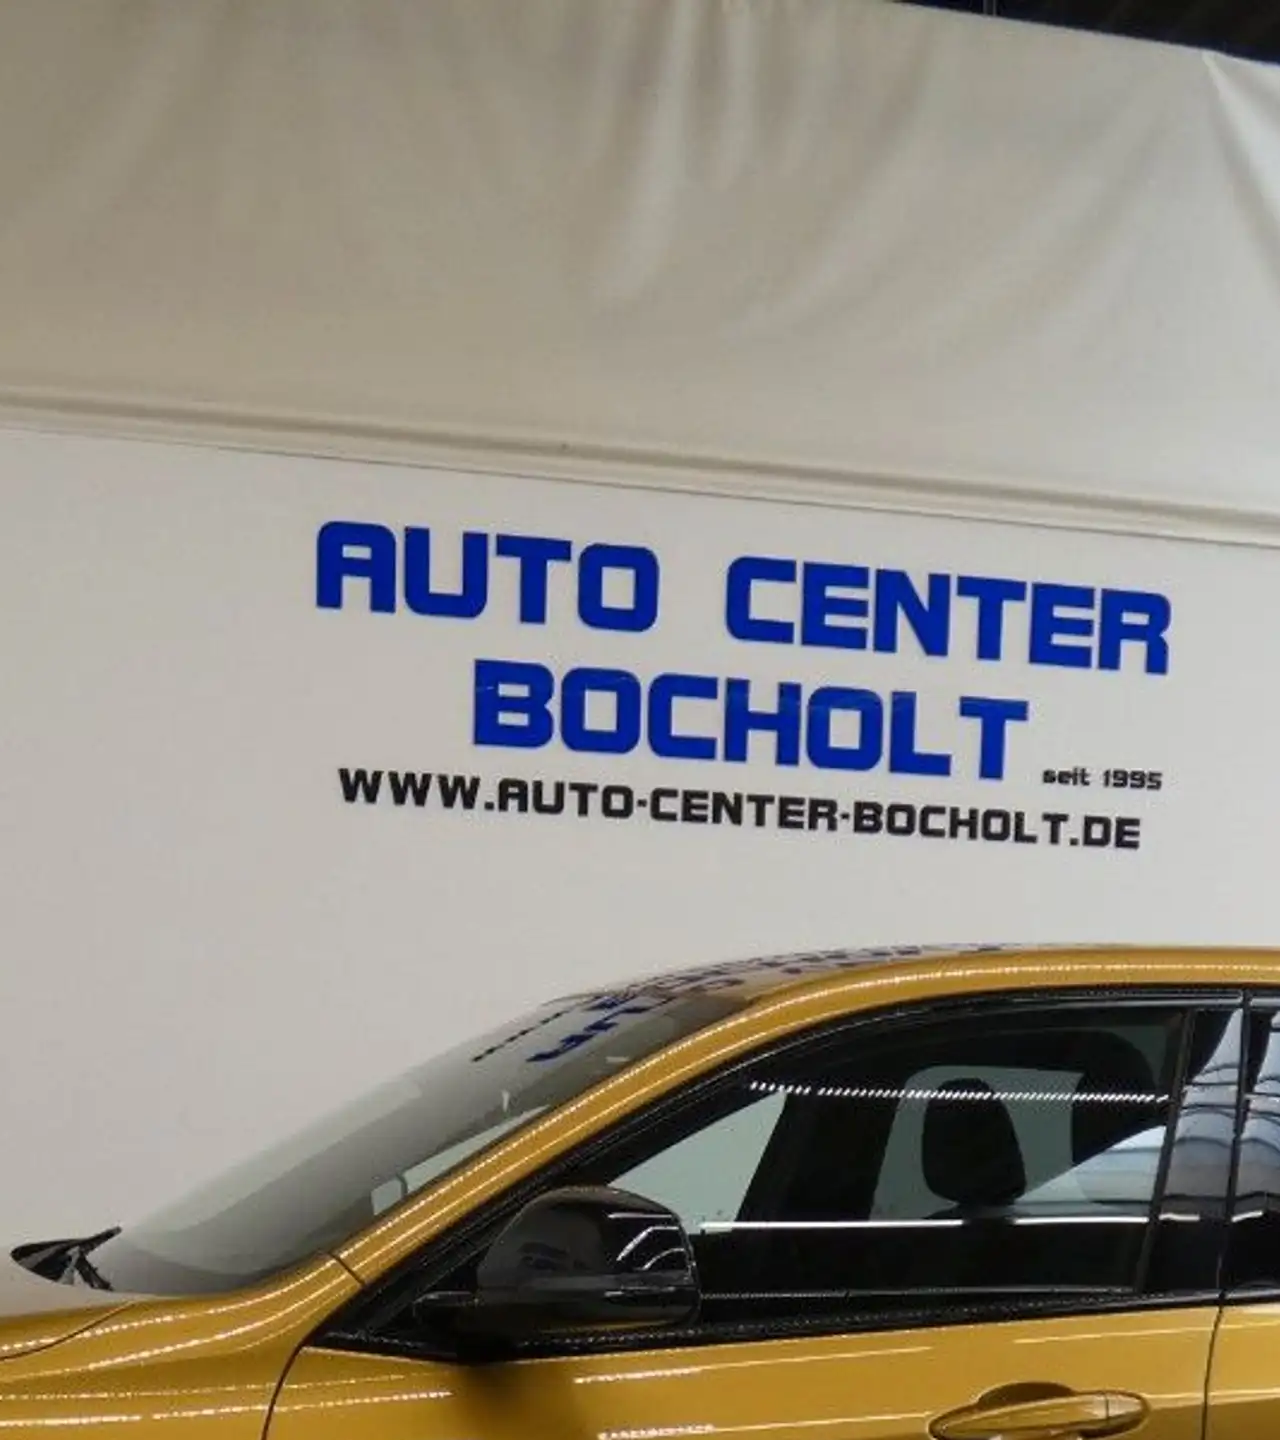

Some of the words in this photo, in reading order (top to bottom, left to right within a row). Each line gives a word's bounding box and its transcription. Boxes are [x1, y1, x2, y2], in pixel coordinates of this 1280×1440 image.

[316, 520, 661, 634] AUTO
[724, 554, 1173, 676] CENTER
[473, 657, 1029, 781] BOCHOLT
[338, 768, 1141, 850] WWW.AUTO-CENTER-BOCHOLT.DE
[1042, 766, 1091, 787] seit
[1103, 768, 1163, 791] 1995
